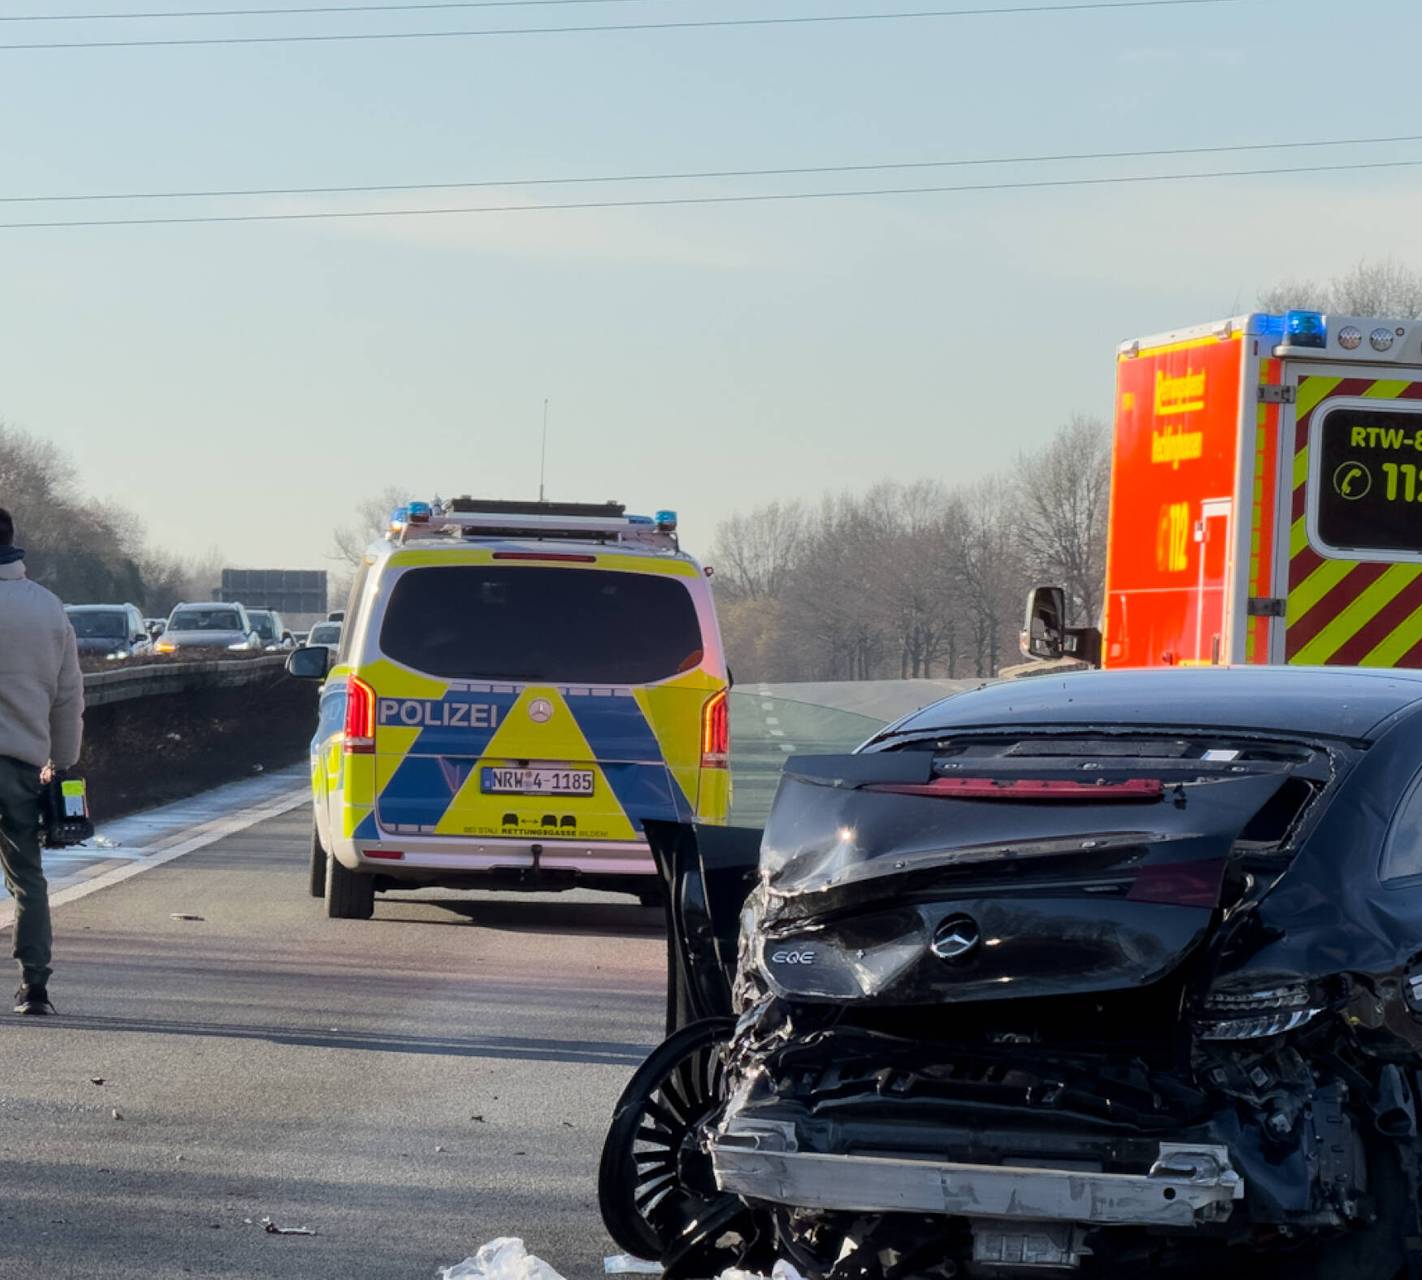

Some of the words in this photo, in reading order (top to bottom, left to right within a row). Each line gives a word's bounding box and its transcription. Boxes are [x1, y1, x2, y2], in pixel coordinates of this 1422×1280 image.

[379, 700, 497, 728] POLIZEI
[492, 768, 523, 788] NRW
[533, 773, 592, 790] 4-1185
[501, 828, 577, 836] RETTUNGSGASSE
[771, 951, 816, 964] EQE
